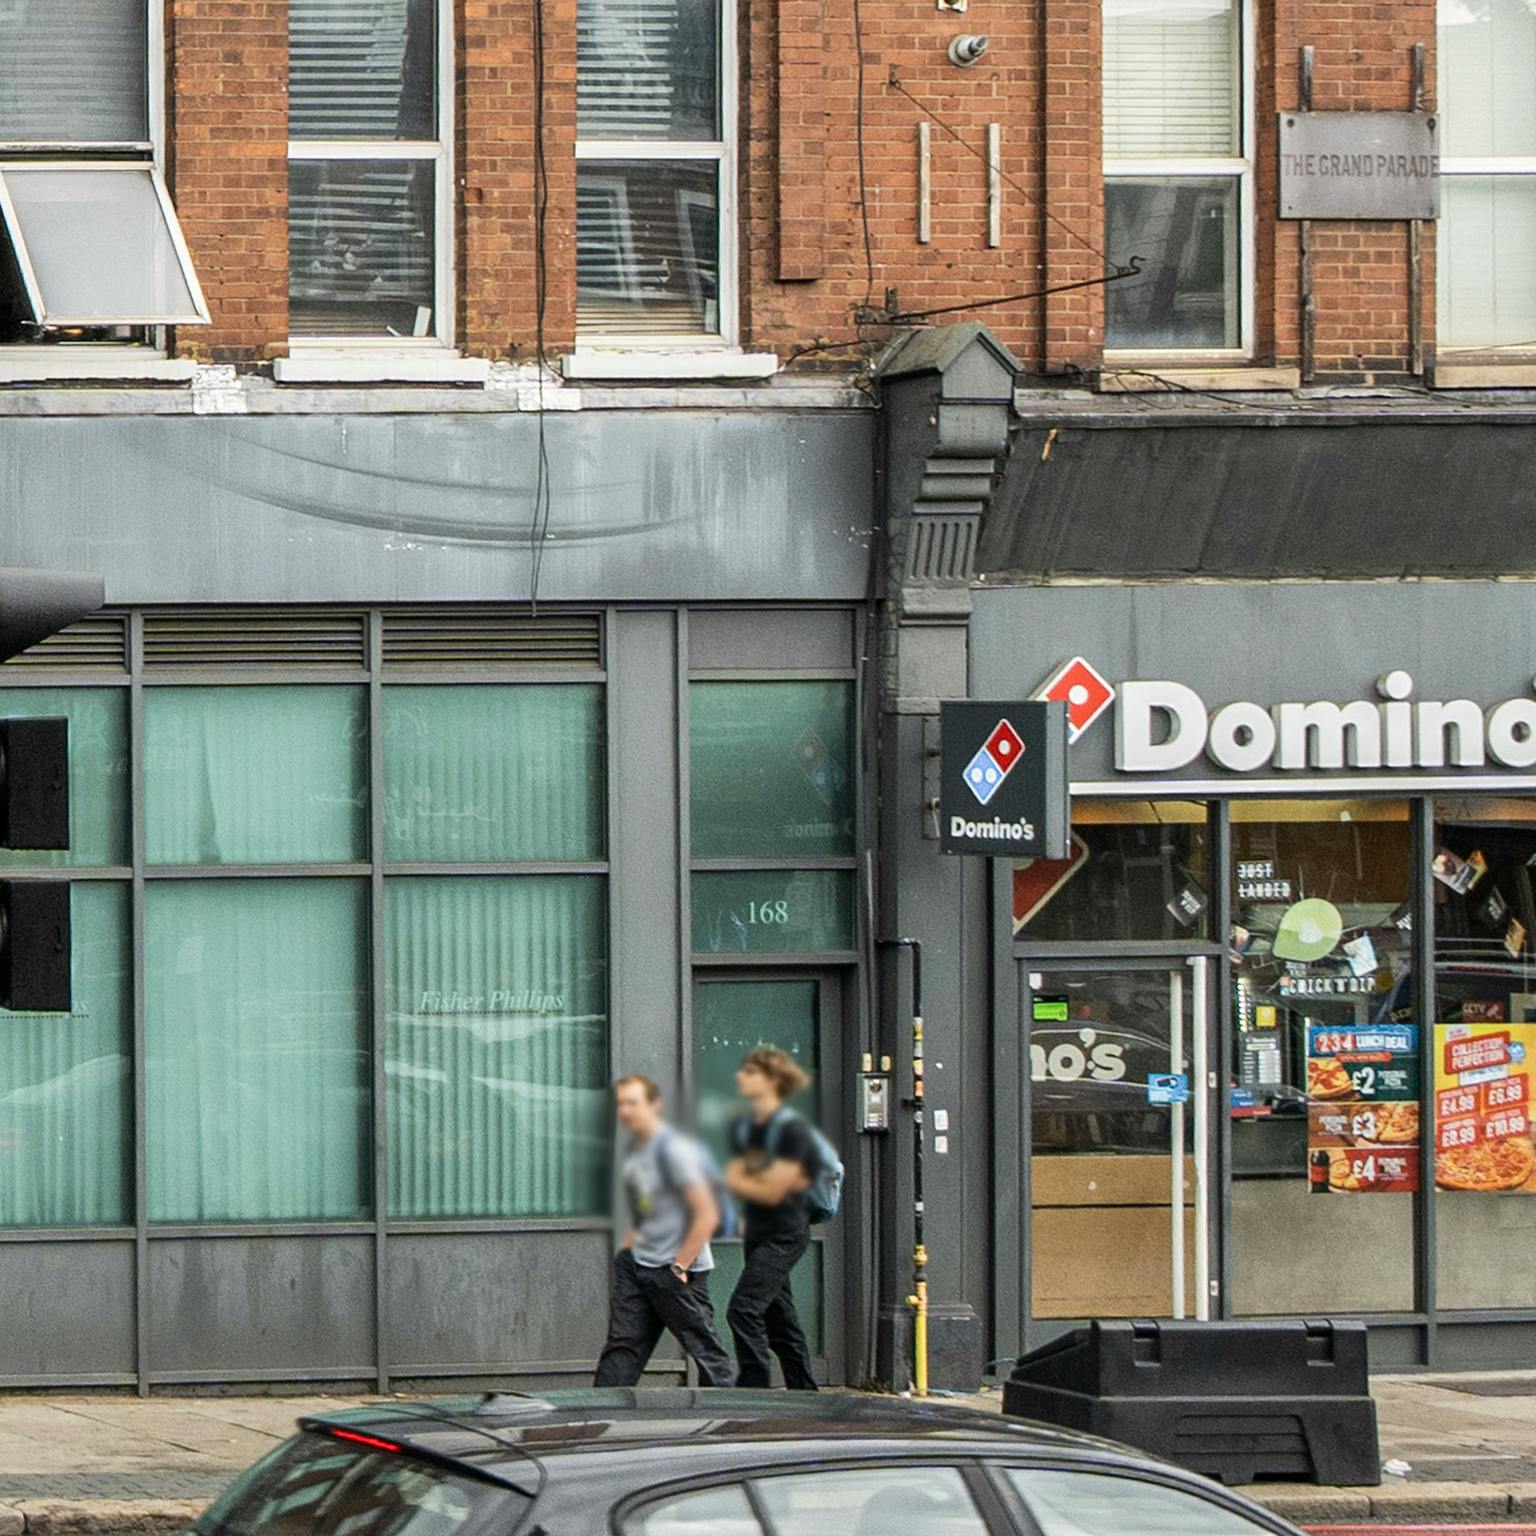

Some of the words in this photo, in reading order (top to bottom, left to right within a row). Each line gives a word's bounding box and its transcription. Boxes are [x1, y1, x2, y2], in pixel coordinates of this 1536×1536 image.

[1283, 154, 1316, 176] THE
[1318, 154, 1374, 177] GRAND
[1376, 154, 1440, 178] PARADE
[950, 815, 1035, 841] Domino's
[1237, 861, 1274, 878] JUST
[1237, 882, 1291, 898] LANDED
[747, 900, 789, 924] 168
[419, 990, 485, 1010] Fisher
[489, 989, 566, 1013] Phillips
[1356, 1034, 1384, 1048] LUNCH
[1385, 1036, 1409, 1049] DEAL
[1351, 1066, 1376, 1095] £2
[1351, 1111, 1377, 1139] £3
[1351, 1154, 1376, 1183] £4
